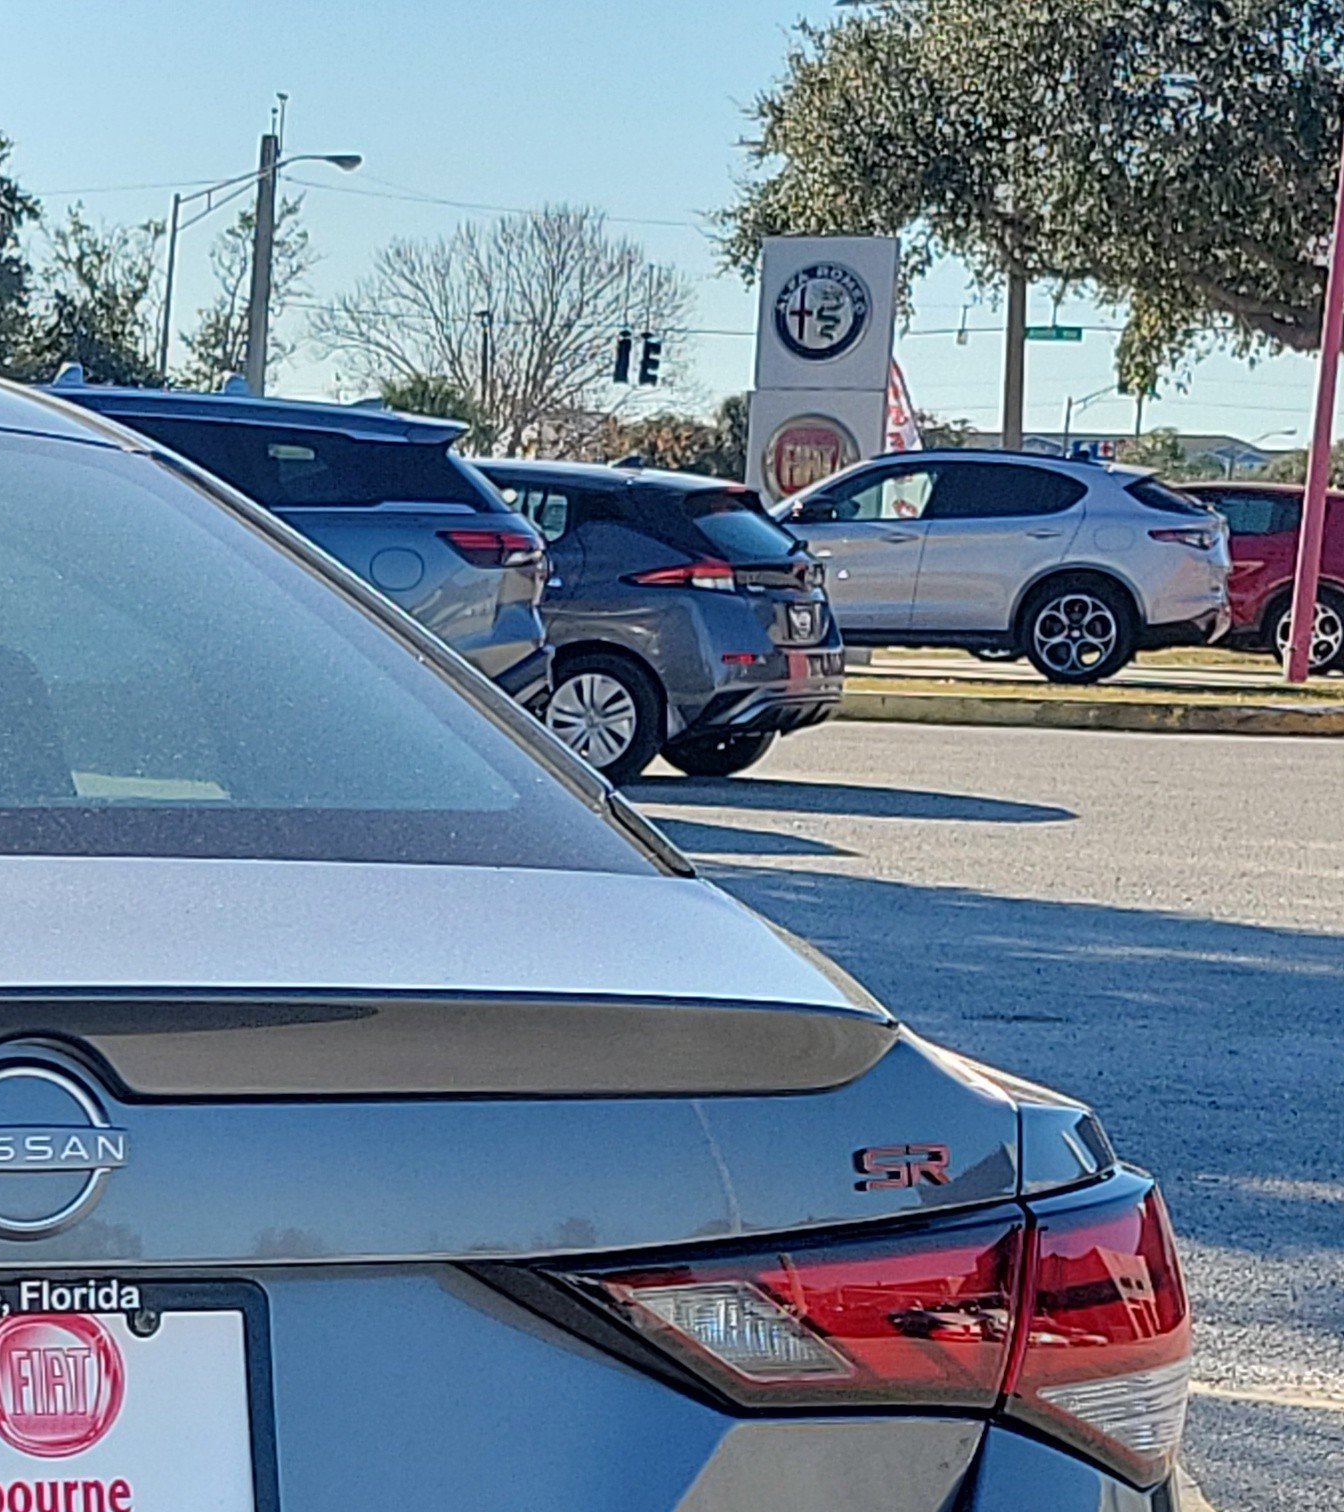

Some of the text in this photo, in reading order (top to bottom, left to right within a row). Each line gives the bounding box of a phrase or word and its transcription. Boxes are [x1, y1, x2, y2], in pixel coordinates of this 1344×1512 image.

[853, 1143, 952, 1191] SR
[20, 1280, 140, 1311] Florida
[10, 1347, 92, 1416] FIAT
